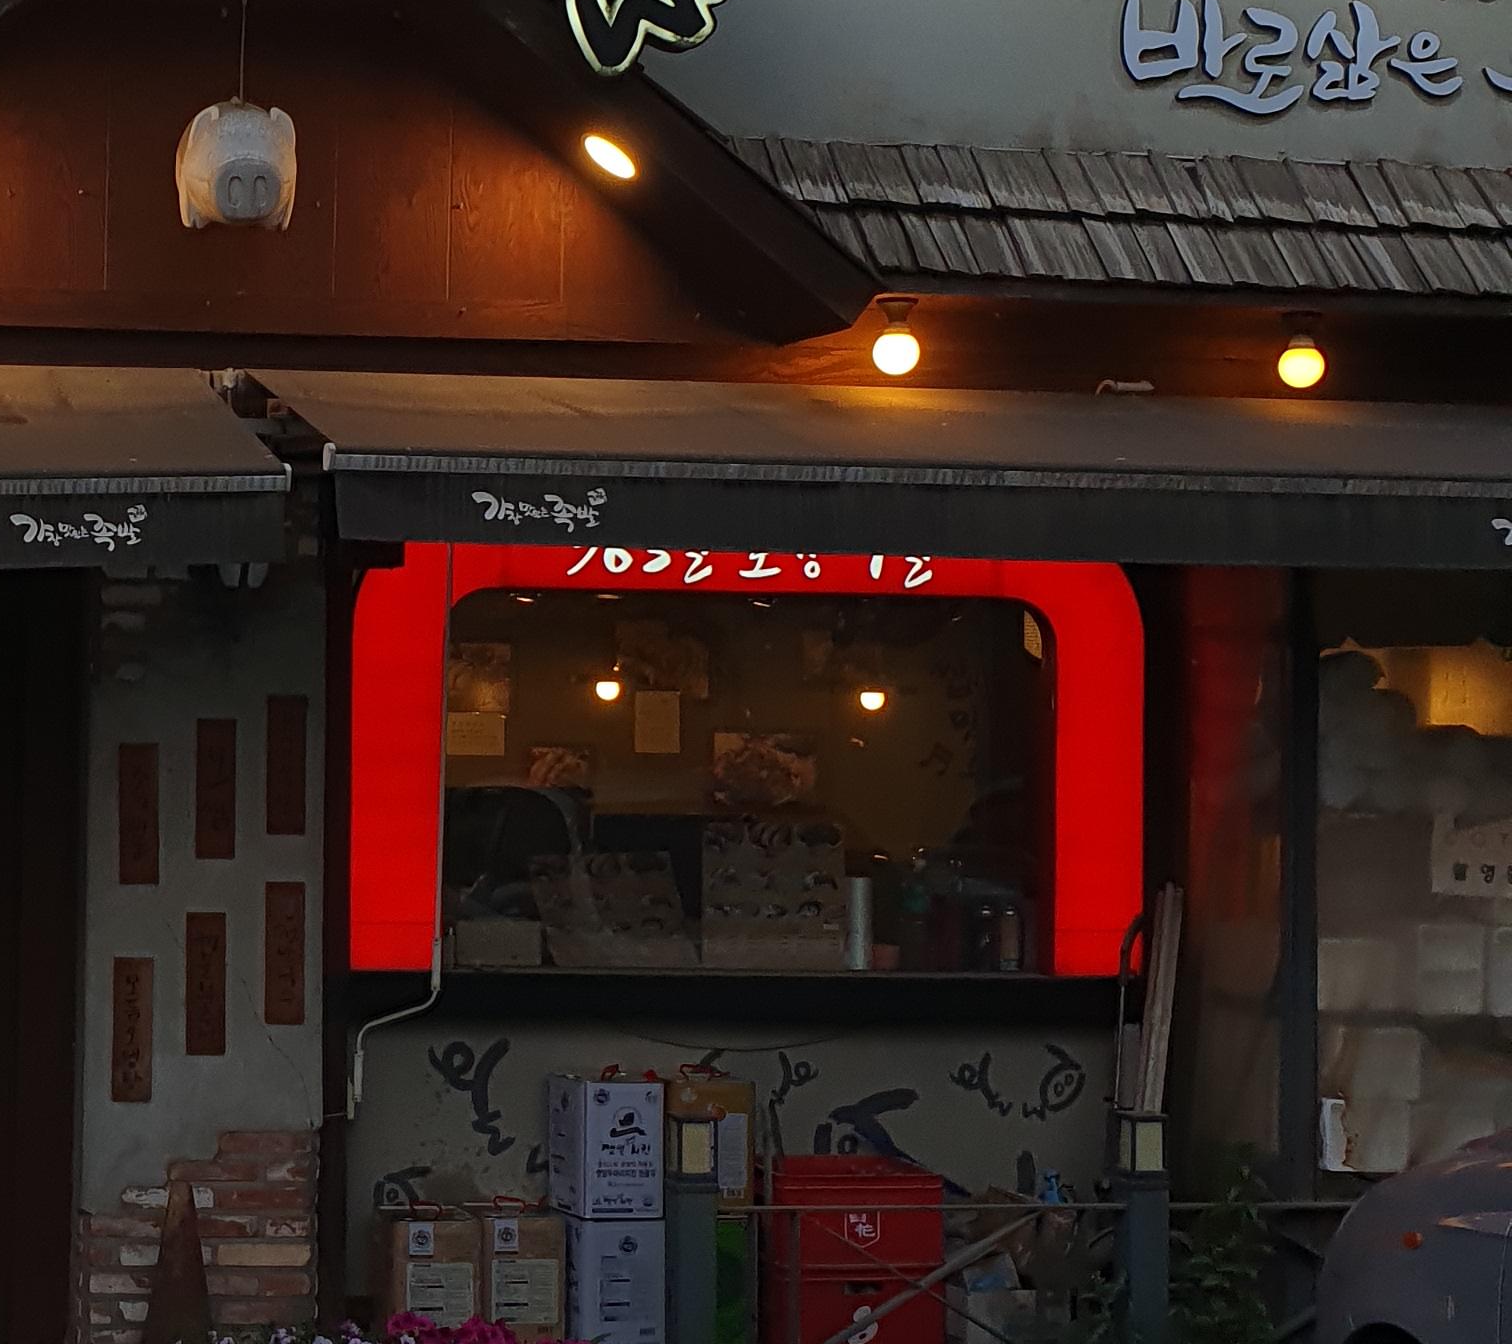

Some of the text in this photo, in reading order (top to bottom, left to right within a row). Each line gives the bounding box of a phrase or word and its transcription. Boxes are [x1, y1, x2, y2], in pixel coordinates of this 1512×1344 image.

[9, 513, 62, 546] 가장
[83, 513, 142, 551] 족발
[471, 491, 523, 525] 가장
[543, 494, 600, 533] 족발
